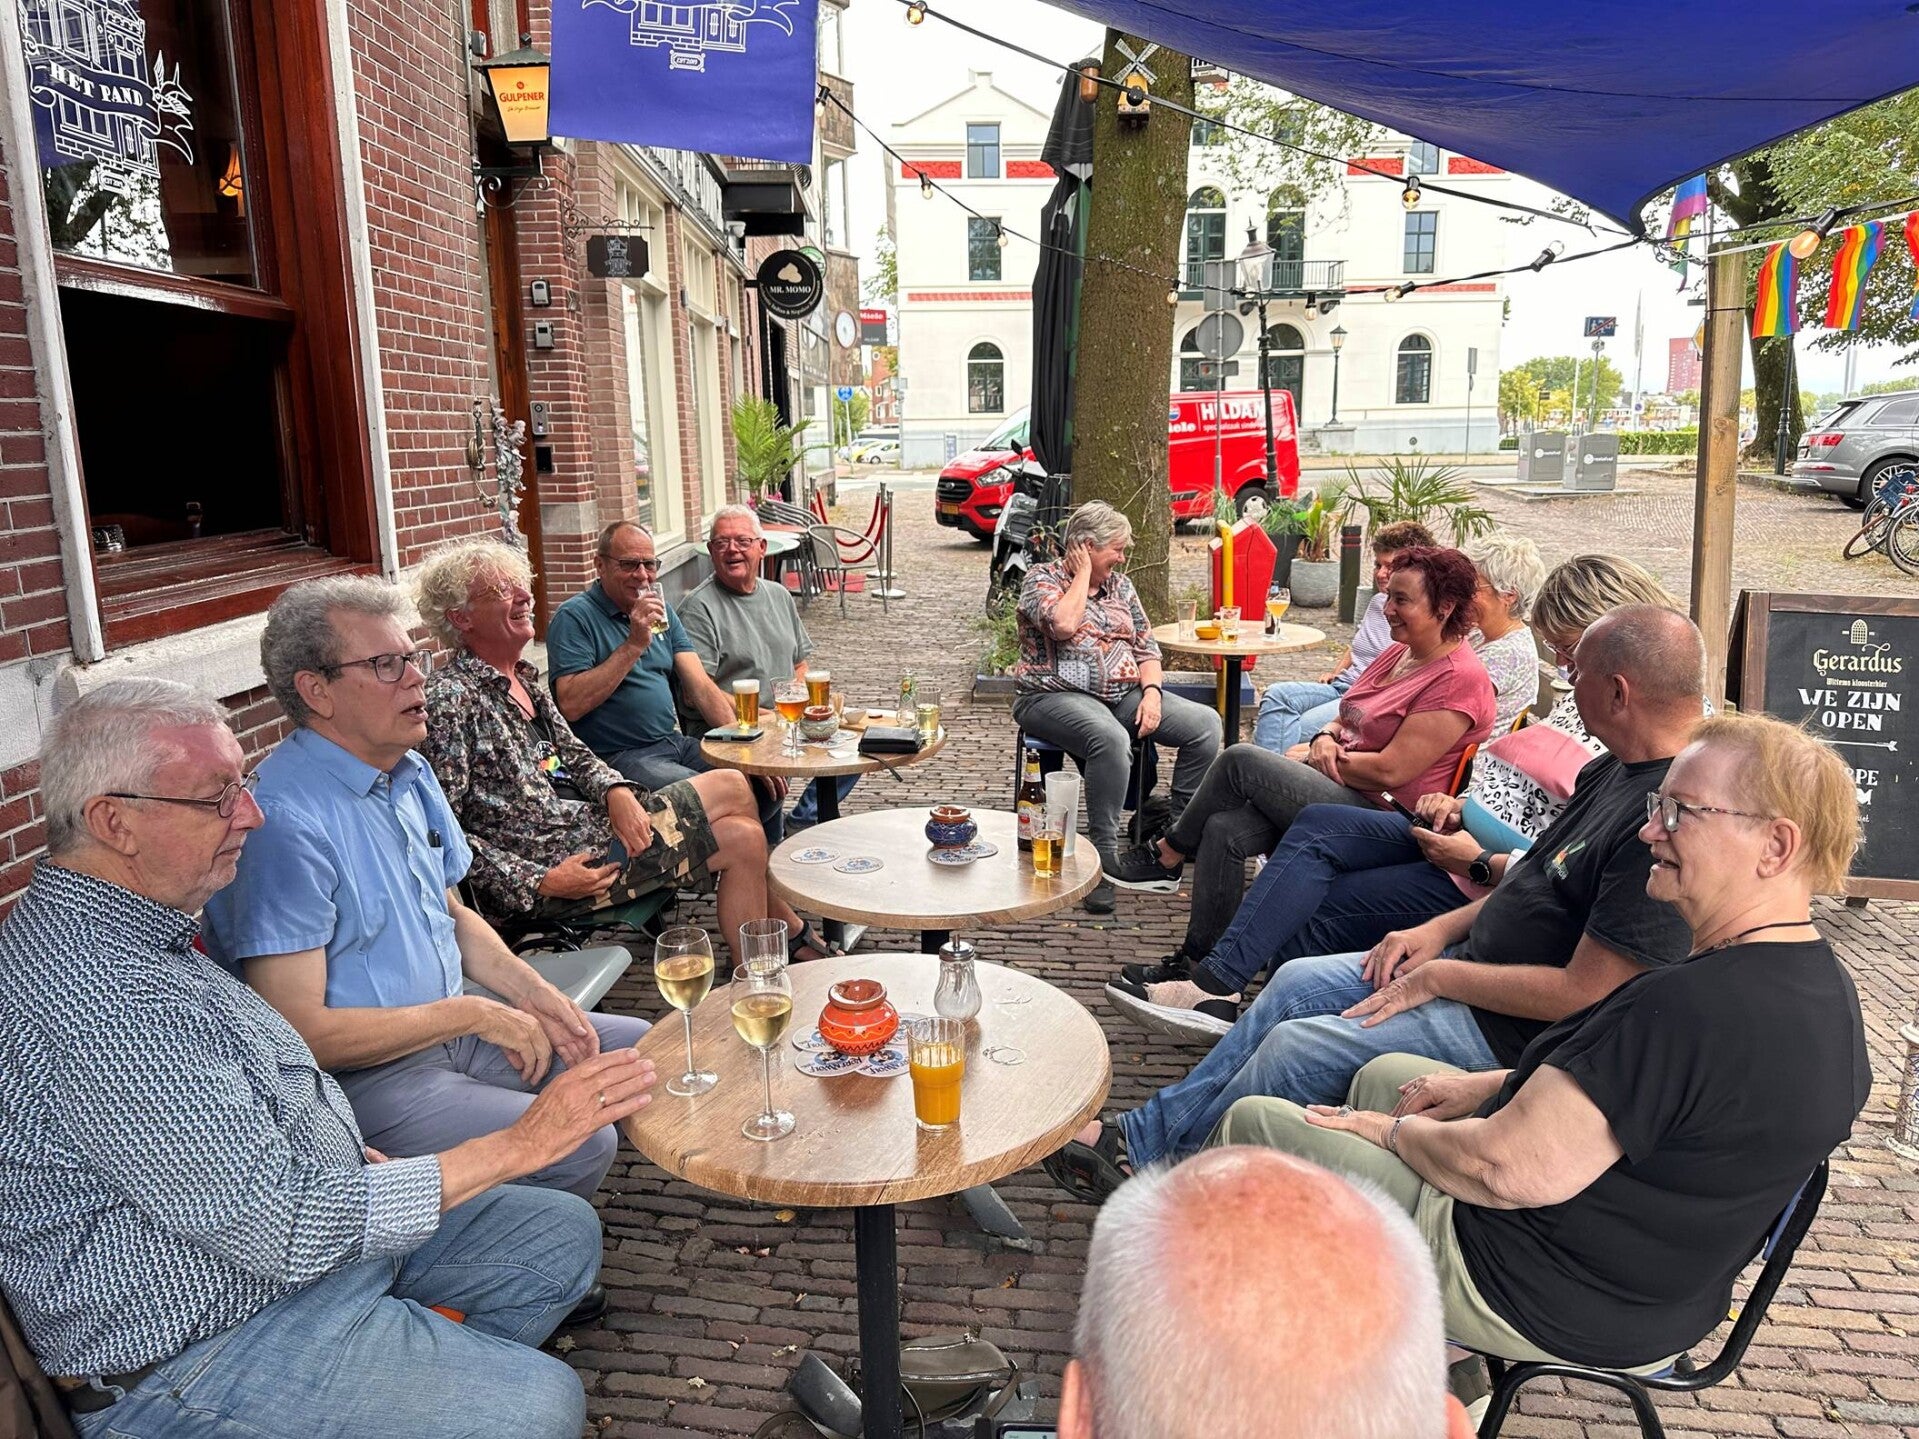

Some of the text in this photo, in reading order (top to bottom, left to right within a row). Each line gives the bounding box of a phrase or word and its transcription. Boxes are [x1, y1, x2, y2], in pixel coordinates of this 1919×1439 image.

[49, 60, 144, 107] HET PAND
[499, 91, 545, 103] GULPENER
[769, 285, 812, 294] MR. MOMO
[1169, 421, 1197, 433] iele
[1813, 643, 1903, 677] Gerardus
[1797, 688, 1902, 712] WE ZIJN
[1821, 710, 1883, 732] OPEN
